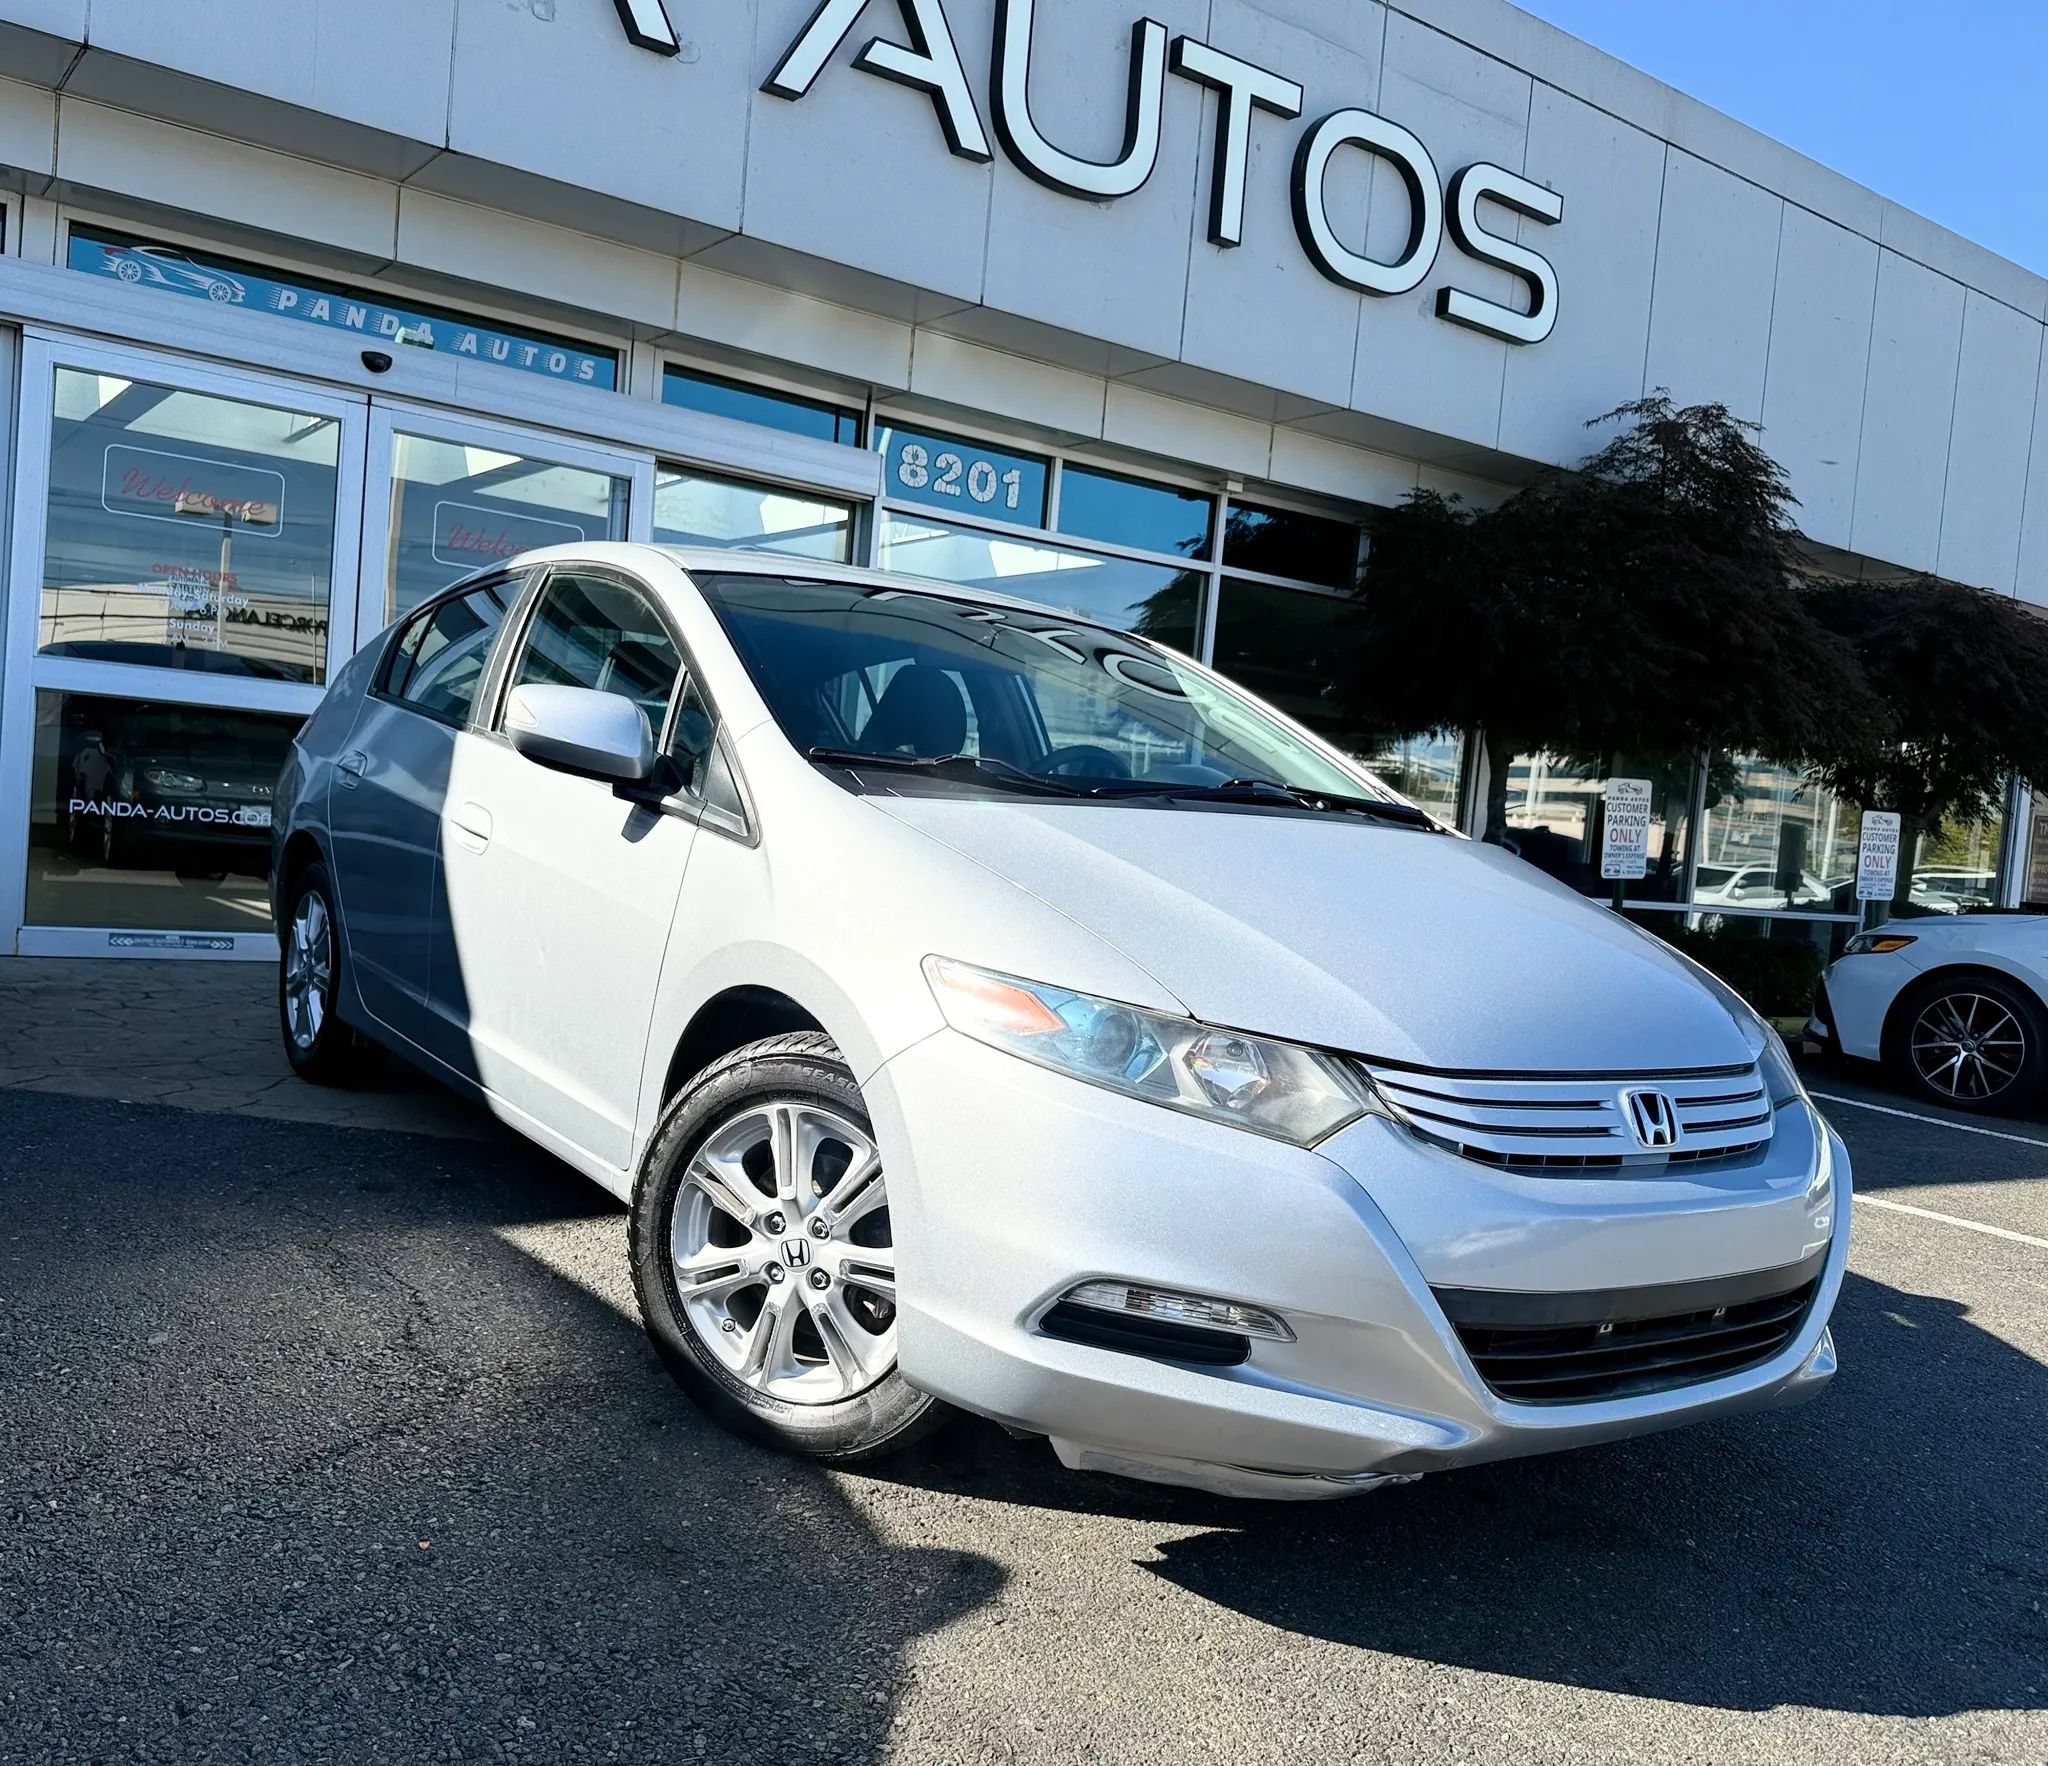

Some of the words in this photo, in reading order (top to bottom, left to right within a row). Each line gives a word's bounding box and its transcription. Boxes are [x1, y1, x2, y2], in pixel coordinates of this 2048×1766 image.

[758, 0, 1564, 345] AUTOS
[270, 287, 434, 345] PANDA
[451, 332, 595, 380] AUTOS
[898, 444, 1021, 509] 8201
[121, 466, 265, 516] Welcome
[169, 618, 215, 635] Sunday
[1606, 801, 1649, 814] CUSTOMER
[1607, 814, 1647, 827] PARKING
[1609, 828, 1642, 844] ONLY
[1862, 832, 1898, 843] CUSTOMER
[1633, 845, 1641, 853] AT
[1862, 843, 1896, 855] PARKING
[1864, 854, 1892, 869] ONLY
[801, 1066, 861, 1095] SEASO
